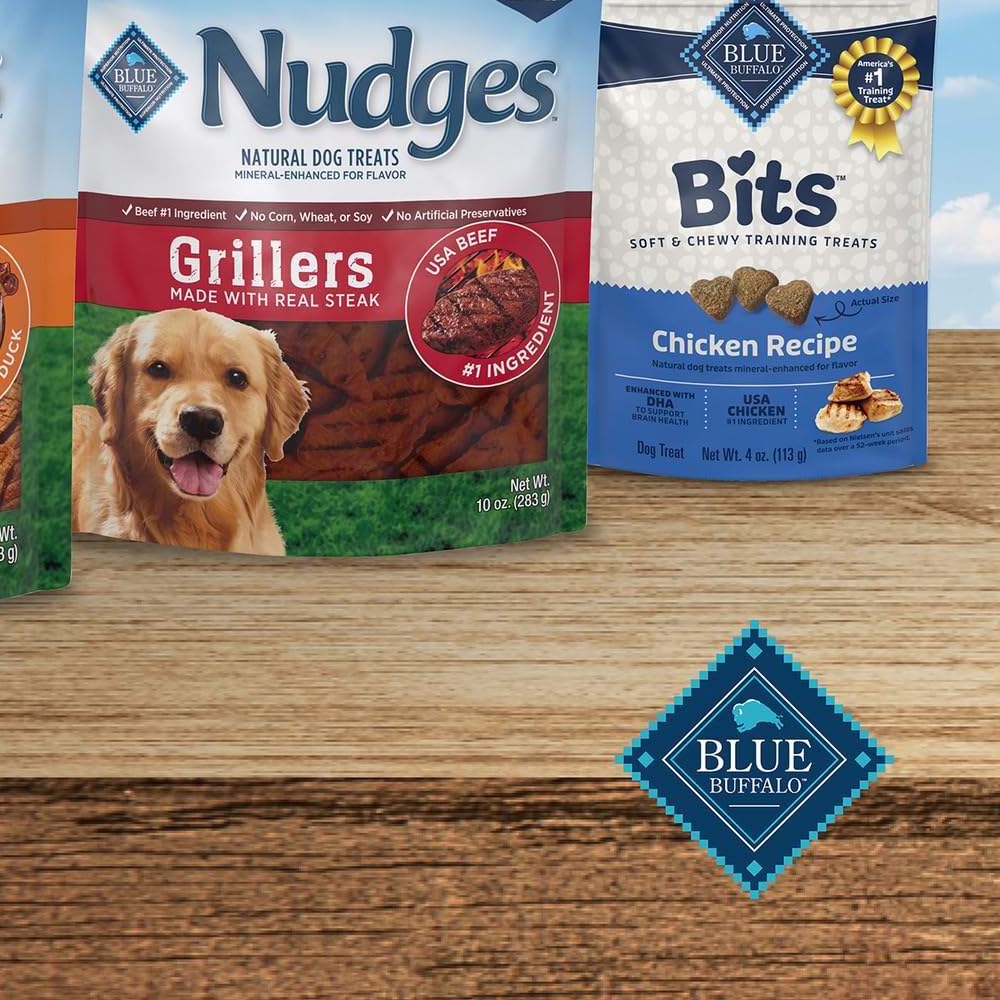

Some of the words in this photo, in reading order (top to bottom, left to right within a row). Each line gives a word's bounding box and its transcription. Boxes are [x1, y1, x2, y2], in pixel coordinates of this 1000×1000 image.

[723, 44, 786, 62] BLUE
[114, 69, 157, 83] BLUE
[865, 68, 882, 86] #1
[858, 87, 893, 95] Training
[241, 149, 307, 166] NATURAL
[313, 149, 341, 166] DOG
[347, 149, 399, 166] TREATS
[135, 206, 158, 217] Beef
[160, 207, 171, 218] #1
[174, 208, 226, 222] Ingredient
[250, 211, 266, 222] No
[268, 211, 296, 224] Corn,
[300, 212, 337, 224] Wheat,
[340, 214, 350, 222] or
[354, 211, 372, 225] Soy
[397, 210, 411, 221] No
[414, 208, 458, 221] Artificial
[461, 207, 527, 219] Preservatives
[630, 238, 665, 249] SOFT
[672, 238, 681, 247] &
[687, 236, 739, 246] CHEWY
[746, 235, 817, 246] TRAINING
[824, 237, 877, 248] TREATS
[426, 246, 456, 276] USA
[456, 229, 497, 250] BEEF
[170, 236, 373, 288] Grillers
[170, 287, 217, 303] MADE
[224, 291, 268, 306] WITH
[276, 293, 318, 307] REAL
[325, 293, 379, 307] STEAK
[462, 362, 481, 378] #1
[487, 291, 555, 377] INGREDIENT
[652, 330, 757, 356] Chicken
[767, 333, 857, 358] Recipe
[626, 385, 671, 397] ENHANCED
[673, 391, 695, 399] WITH
[743, 395, 770, 404] USA
[647, 397, 674, 408] DHA
[728, 406, 785, 416] CHICKEN
[637, 440, 656, 459] Dog
[659, 443, 684, 459] Treat
[702, 447, 719, 461] Net
[723, 448, 742, 462] Wt.
[746, 448, 751, 461] 4
[756, 452, 768, 462] oz.
[773, 448, 793, 463] (113
[797, 448, 806, 463] g)
[511, 478, 529, 492] Net
[533, 474, 550, 489] Wt.
[477, 498, 490, 512] 10
[494, 499, 510, 509] oz.
[514, 493, 538, 510] (283
[541, 490, 550, 507] g)
[0, 525, 17, 542] Wt.
[8, 544, 17, 563] g)
